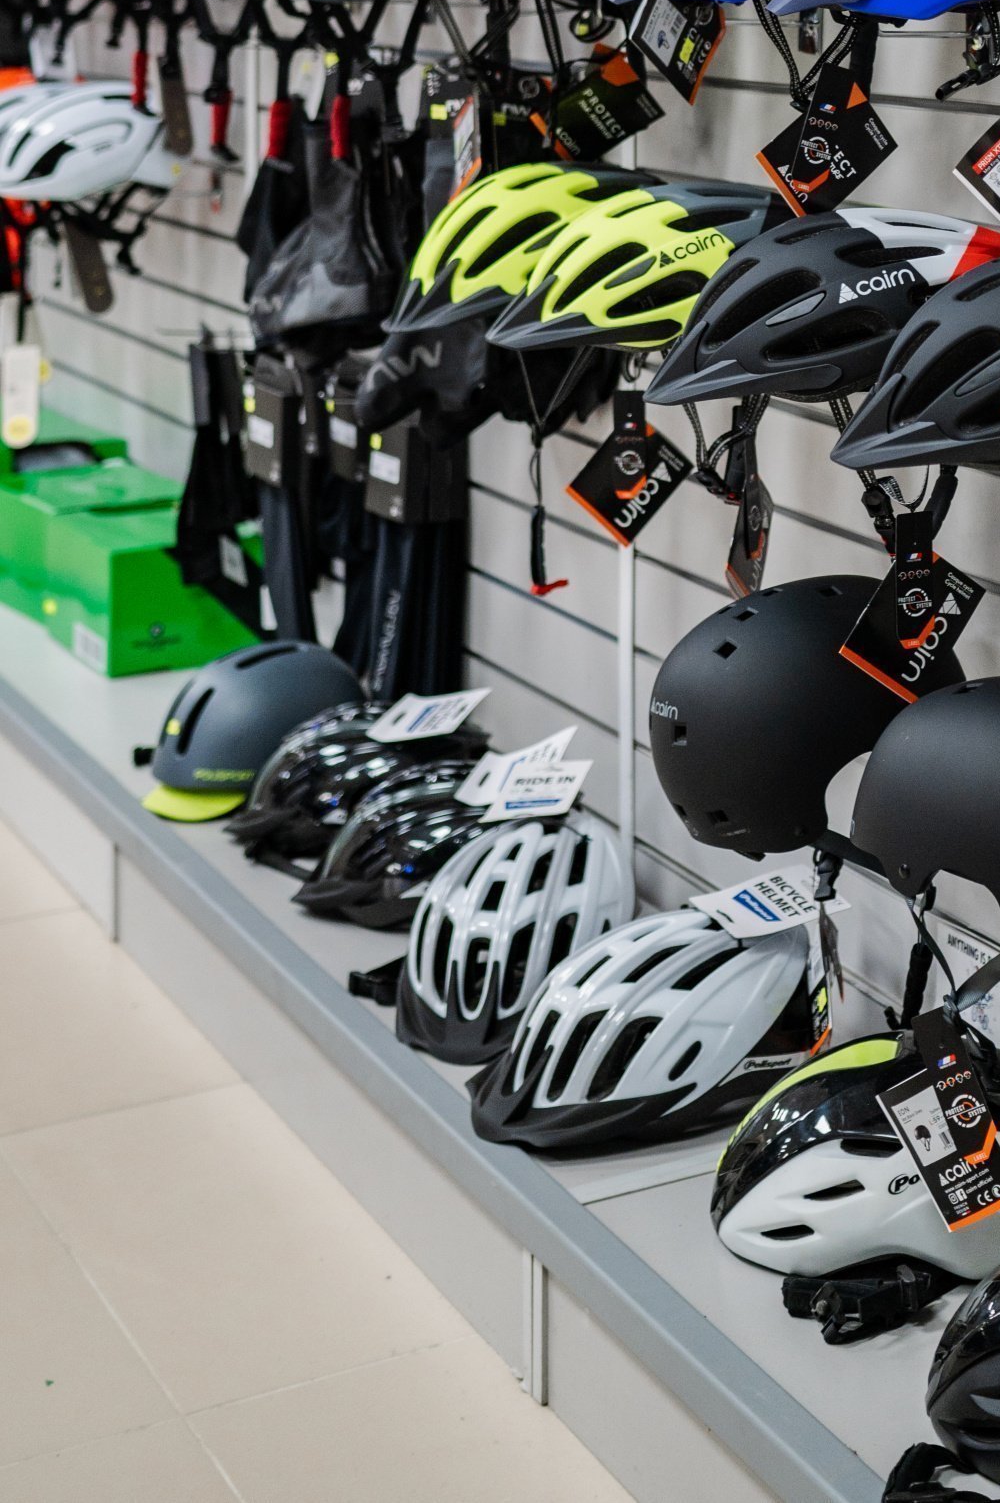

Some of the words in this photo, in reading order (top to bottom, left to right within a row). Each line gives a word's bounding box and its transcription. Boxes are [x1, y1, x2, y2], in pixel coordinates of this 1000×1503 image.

[583, 87, 626, 138] PROTECT
[977, 152, 996, 171] PRISM
[673, 231, 725, 264] cairn
[857, 266, 916, 297] cairn
[614, 478, 660, 528] cairn
[900, 615, 949, 683] cairn
[655, 700, 679, 721] cairn
[515, 776, 553, 787] RIDE
[552, 775, 577, 785] IN
[754, 881, 802, 919] HELMET
[768, 875, 817, 914] BICYCLE
[947, 933, 980, 961] ANYTHING
[945, 1103, 966, 1118] PROTECT
[967, 1107, 988, 1119] SYSTEM
